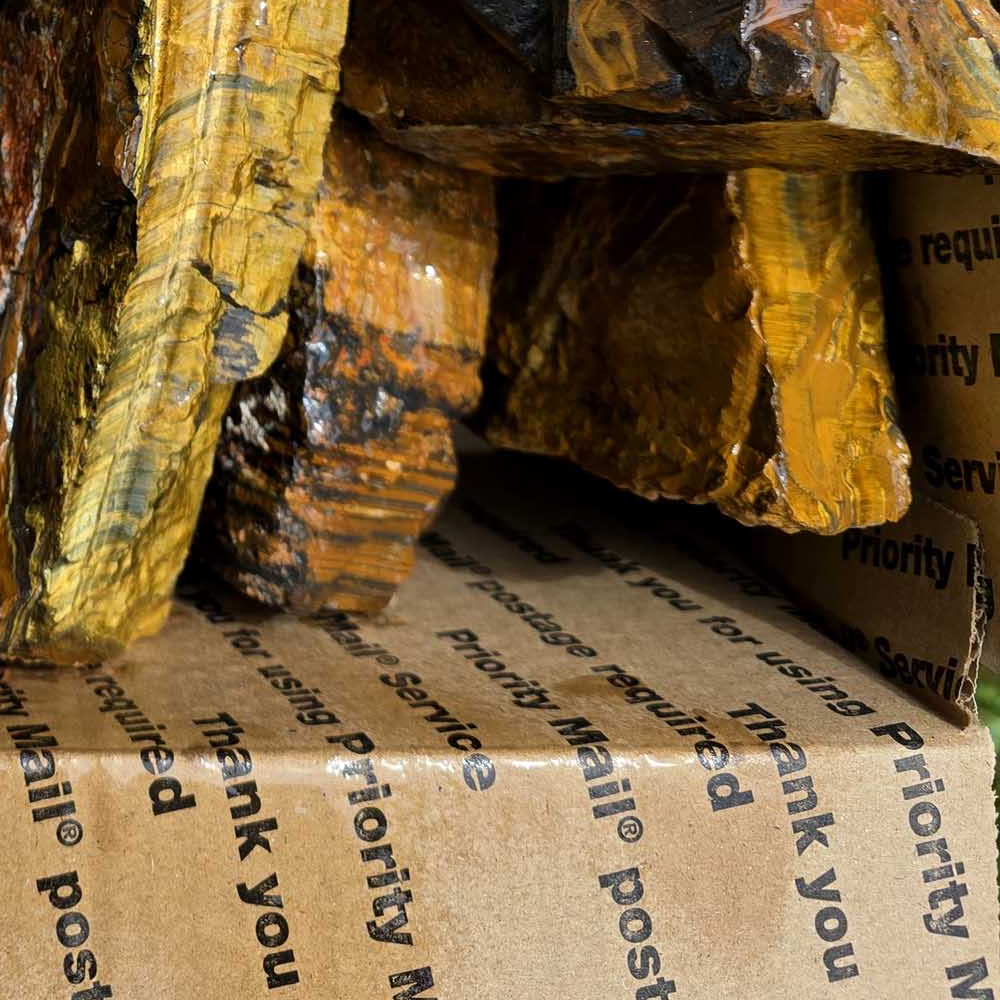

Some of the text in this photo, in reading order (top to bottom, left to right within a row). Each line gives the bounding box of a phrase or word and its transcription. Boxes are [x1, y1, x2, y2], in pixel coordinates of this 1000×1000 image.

[841, 529, 955, 590] Priority
[6, 722, 84, 848] Mail®
[85, 672, 197, 817] required
[222, 626, 416, 948] for using Priority
[378, 670, 498, 793] Service
[434, 626, 562, 712] Priority
[546, 715, 645, 845] Mail®
[462, 578, 600, 660] postage
[590, 662, 755, 813] required
[624, 576, 704, 612] you
[696, 614, 766, 647] for
[755, 650, 878, 718] using
[868, 721, 970, 940] Priority
[191, 711, 300, 991] Thank you
[727, 701, 836, 857] Thank
[794, 867, 860, 985] you
